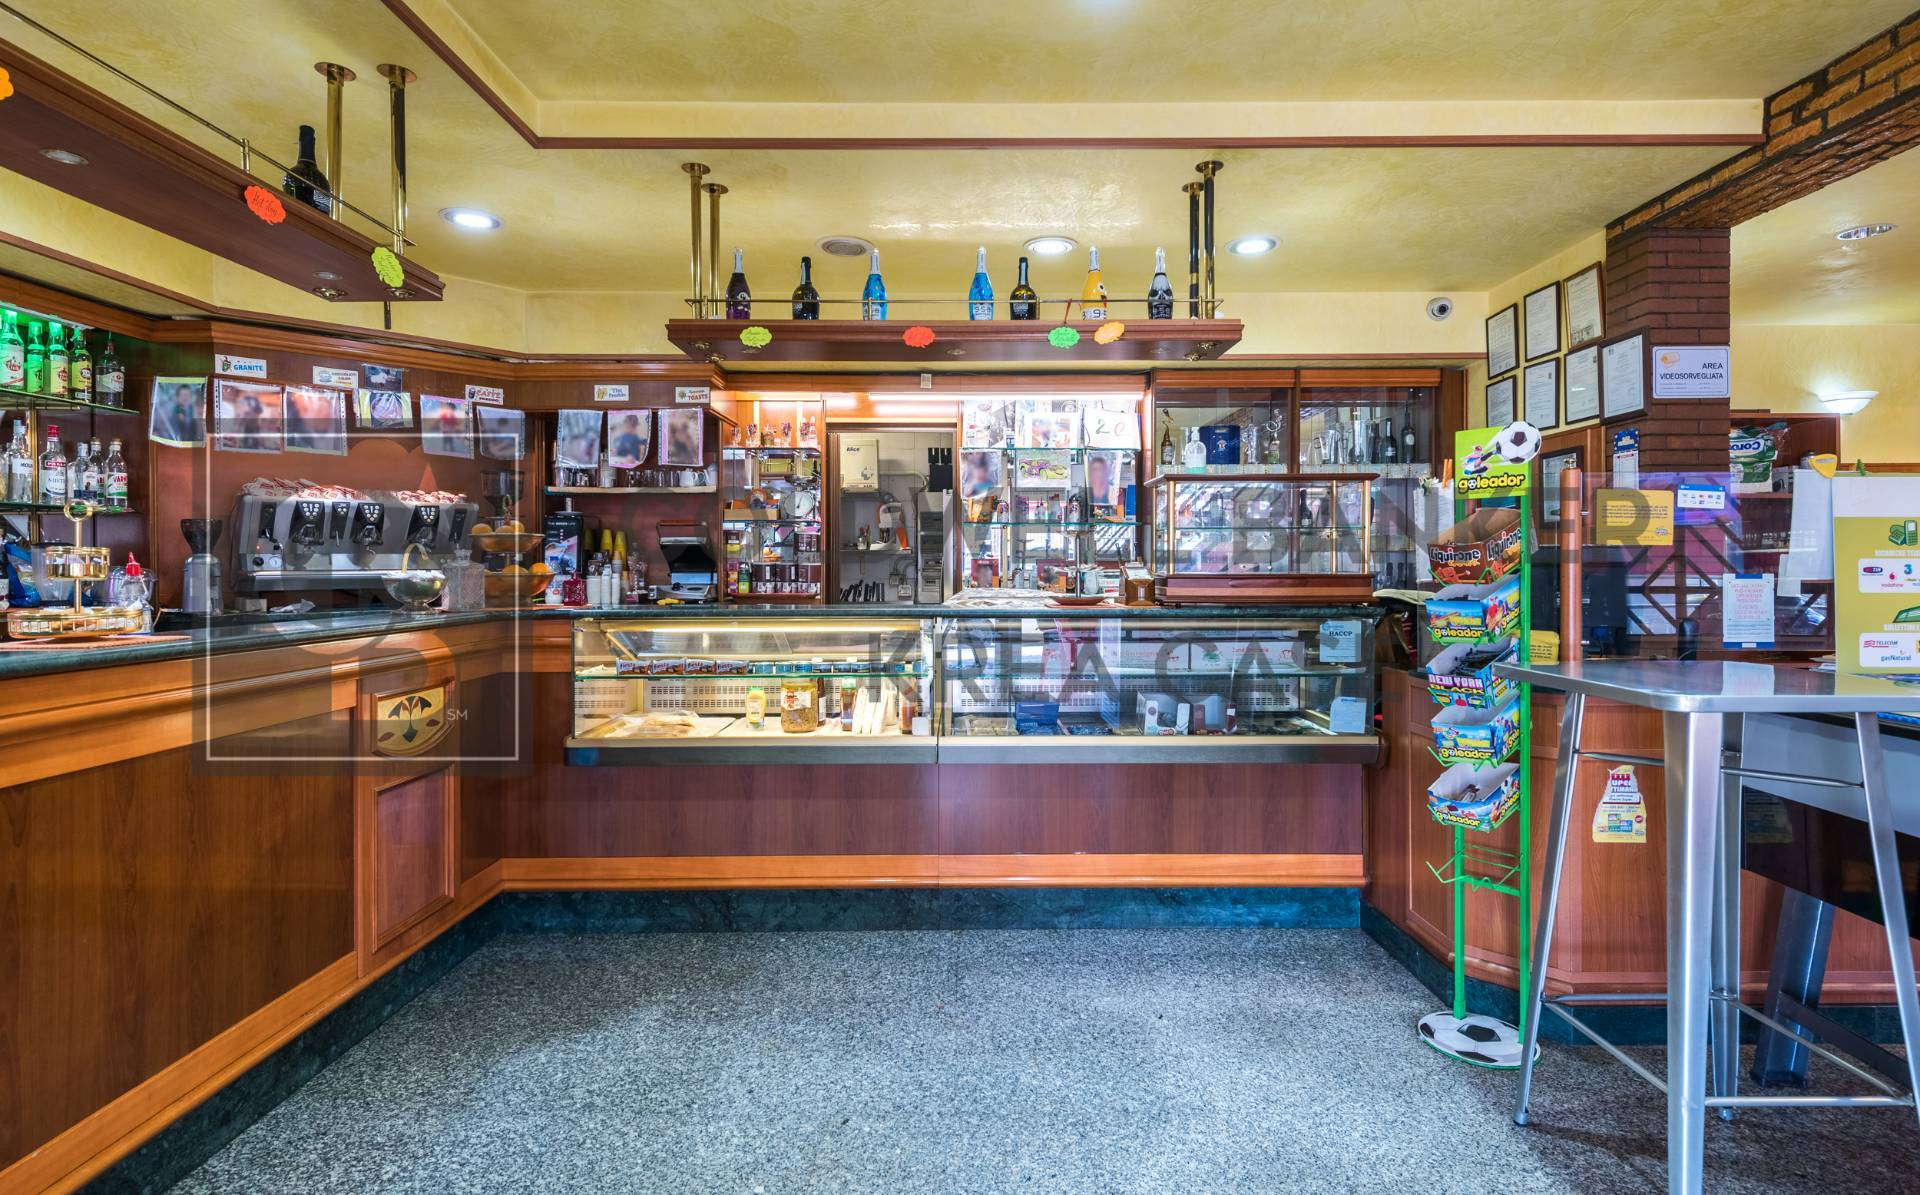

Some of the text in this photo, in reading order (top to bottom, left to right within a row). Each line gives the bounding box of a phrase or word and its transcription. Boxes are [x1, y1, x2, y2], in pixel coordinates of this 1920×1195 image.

[233, 364, 264, 372] GRANITE
[1701, 362, 1724, 370] AREA
[1659, 372, 1724, 380] VIDEOSORVEGLIATA
[1458, 473, 1525, 493] goleador
[1428, 548, 1481, 562] Liquirone
[1434, 627, 1482, 638] goleador
[1428, 674, 1484, 688] NEW YORK
[1430, 684, 1485, 694] BLACK
[1441, 747, 1491, 759] goleador
[1437, 810, 1481, 827] goleador
